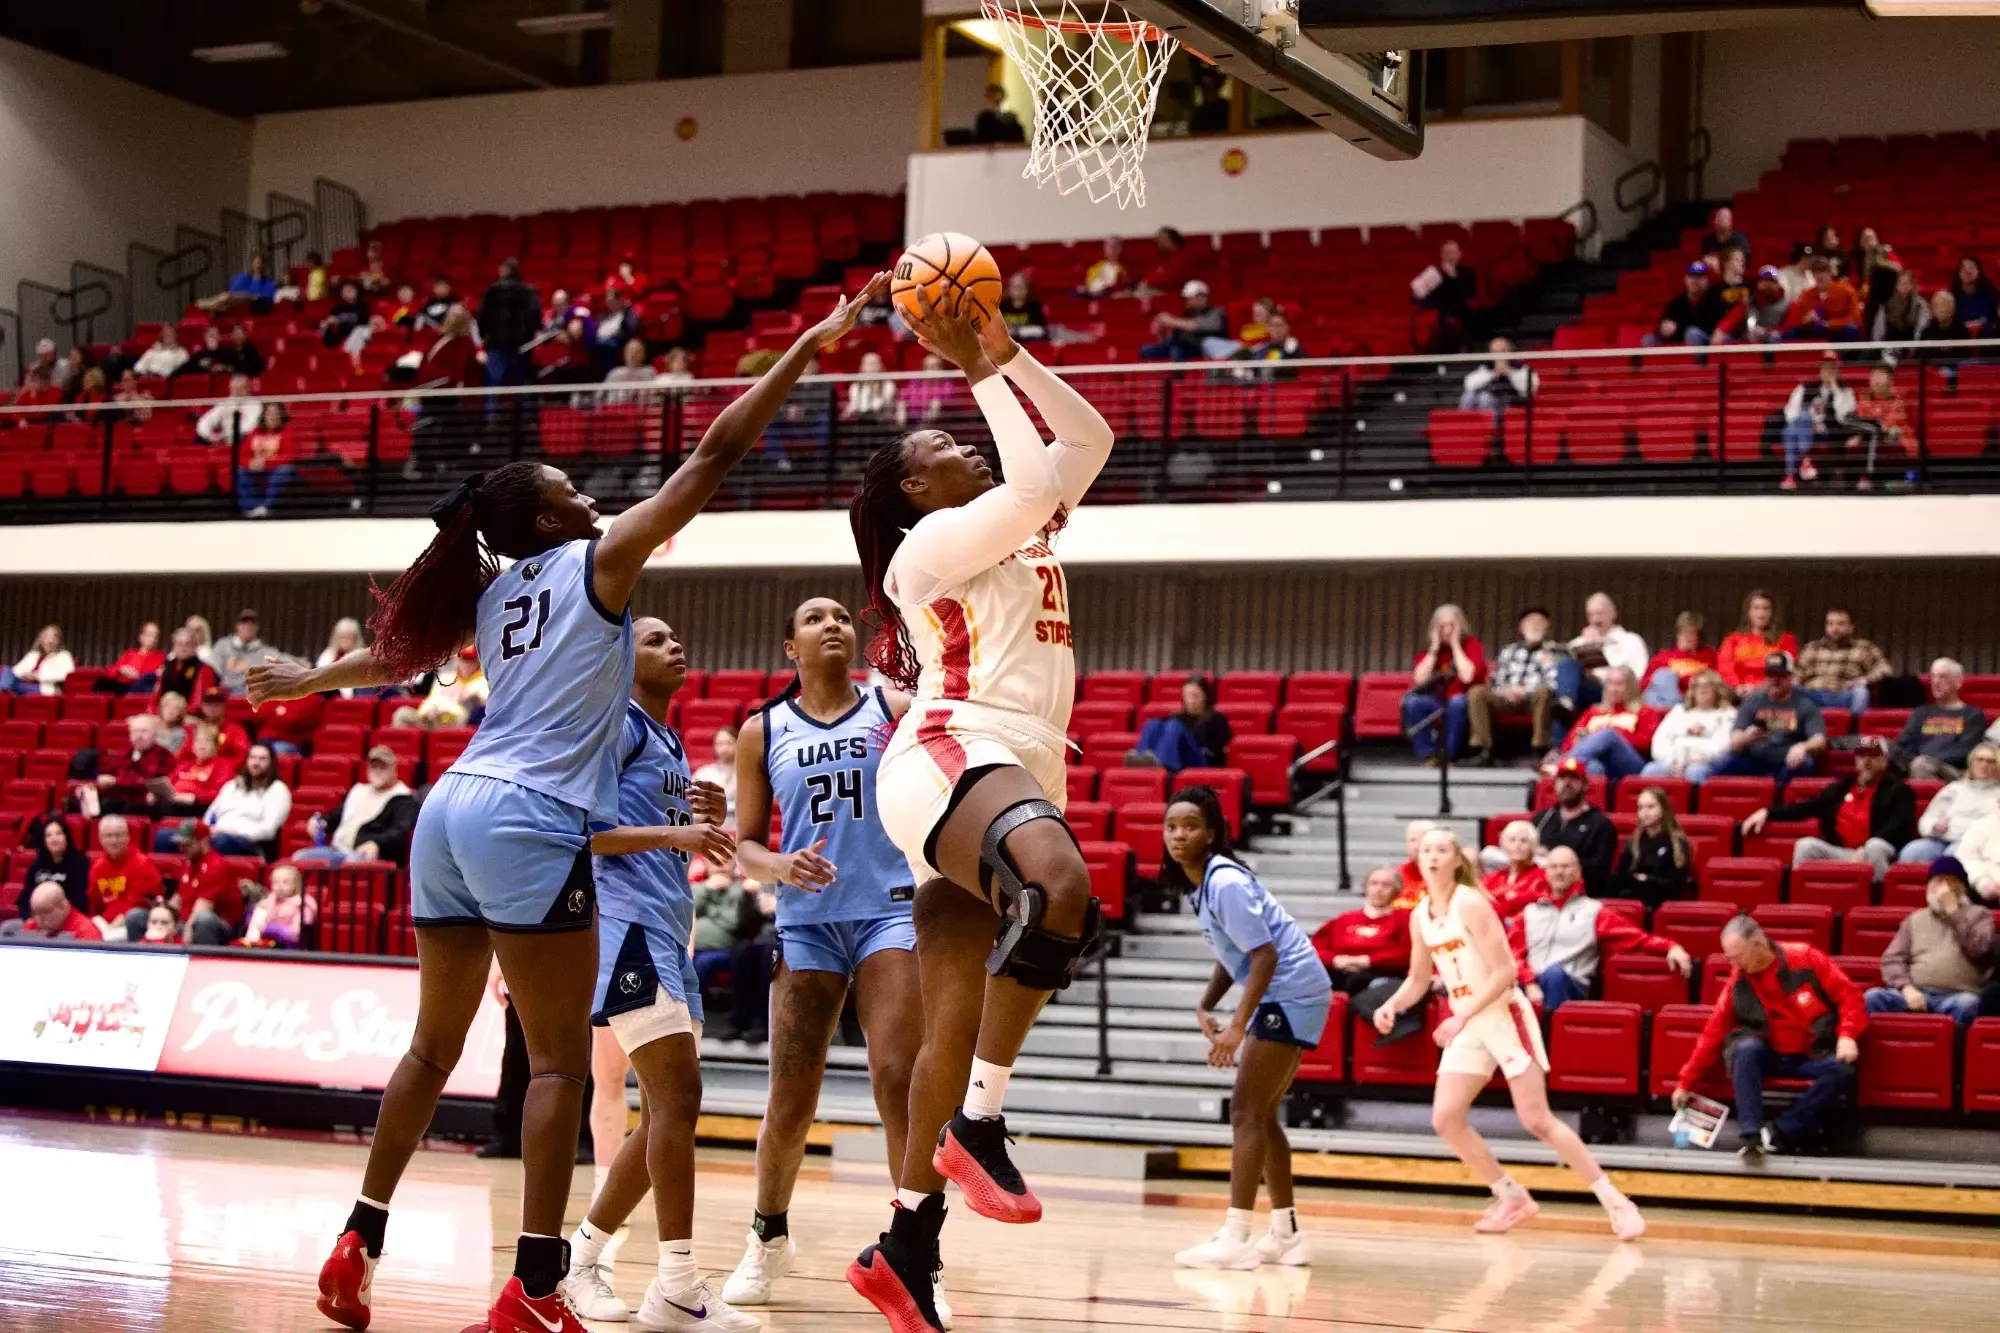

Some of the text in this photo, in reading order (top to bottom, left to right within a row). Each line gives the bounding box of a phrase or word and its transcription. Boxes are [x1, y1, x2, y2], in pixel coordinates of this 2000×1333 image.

[1036, 566, 1065, 613] 21
[501, 587, 552, 661] 21
[797, 737, 868, 768] UAFS
[663, 769, 692, 801] UAF
[805, 768, 864, 826] 24
[181, 981, 419, 1062] Pitt Sta
